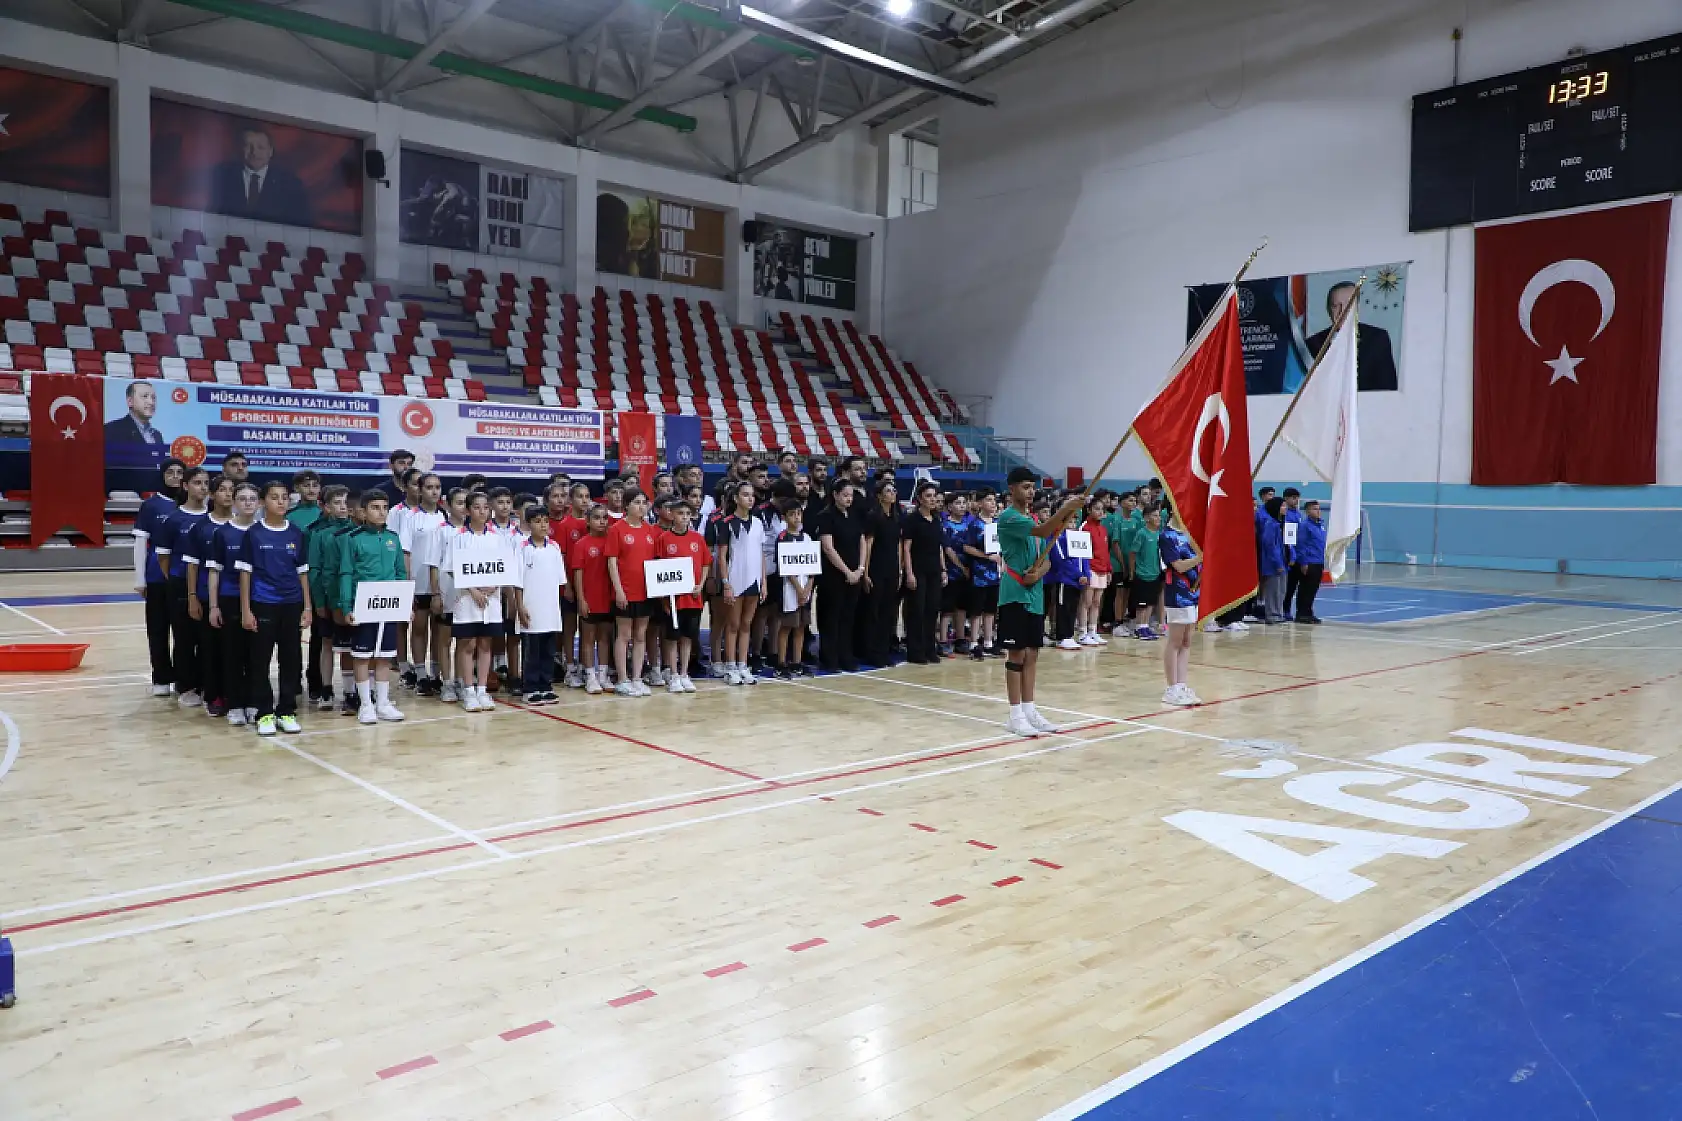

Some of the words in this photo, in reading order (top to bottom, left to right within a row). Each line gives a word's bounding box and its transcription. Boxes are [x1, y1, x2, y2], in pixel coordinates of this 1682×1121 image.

[1549, 72, 1608, 103] 13:33
[1585, 166, 1613, 182] SCORE
[1530, 176, 1556, 192] SCORE
[210, 391, 299, 407] MÜSABAKALARA
[301, 398, 346, 410] KATILAN
[347, 400, 370, 411] TÜM
[231, 411, 273, 423] SPORCU
[277, 413, 291, 424] VE
[292, 414, 372, 429] ANTRENÖRLERE
[468, 406, 539, 421] MÜSABAKALARA
[540, 412, 575, 423] KATILAN
[576, 413, 593, 424] TÜM
[243, 430, 303, 443] BAŞARILAR
[484, 425, 518, 435] SPORCU
[519, 427, 531, 437] VE
[532, 427, 596, 439] ANTRENÖRLERE
[493, 440, 541, 452] BAŞARILAR
[462, 558, 505, 575] ELAZIĞ
[656, 570, 683, 584] KARS
[1161, 727, 1657, 902] AĞRI
